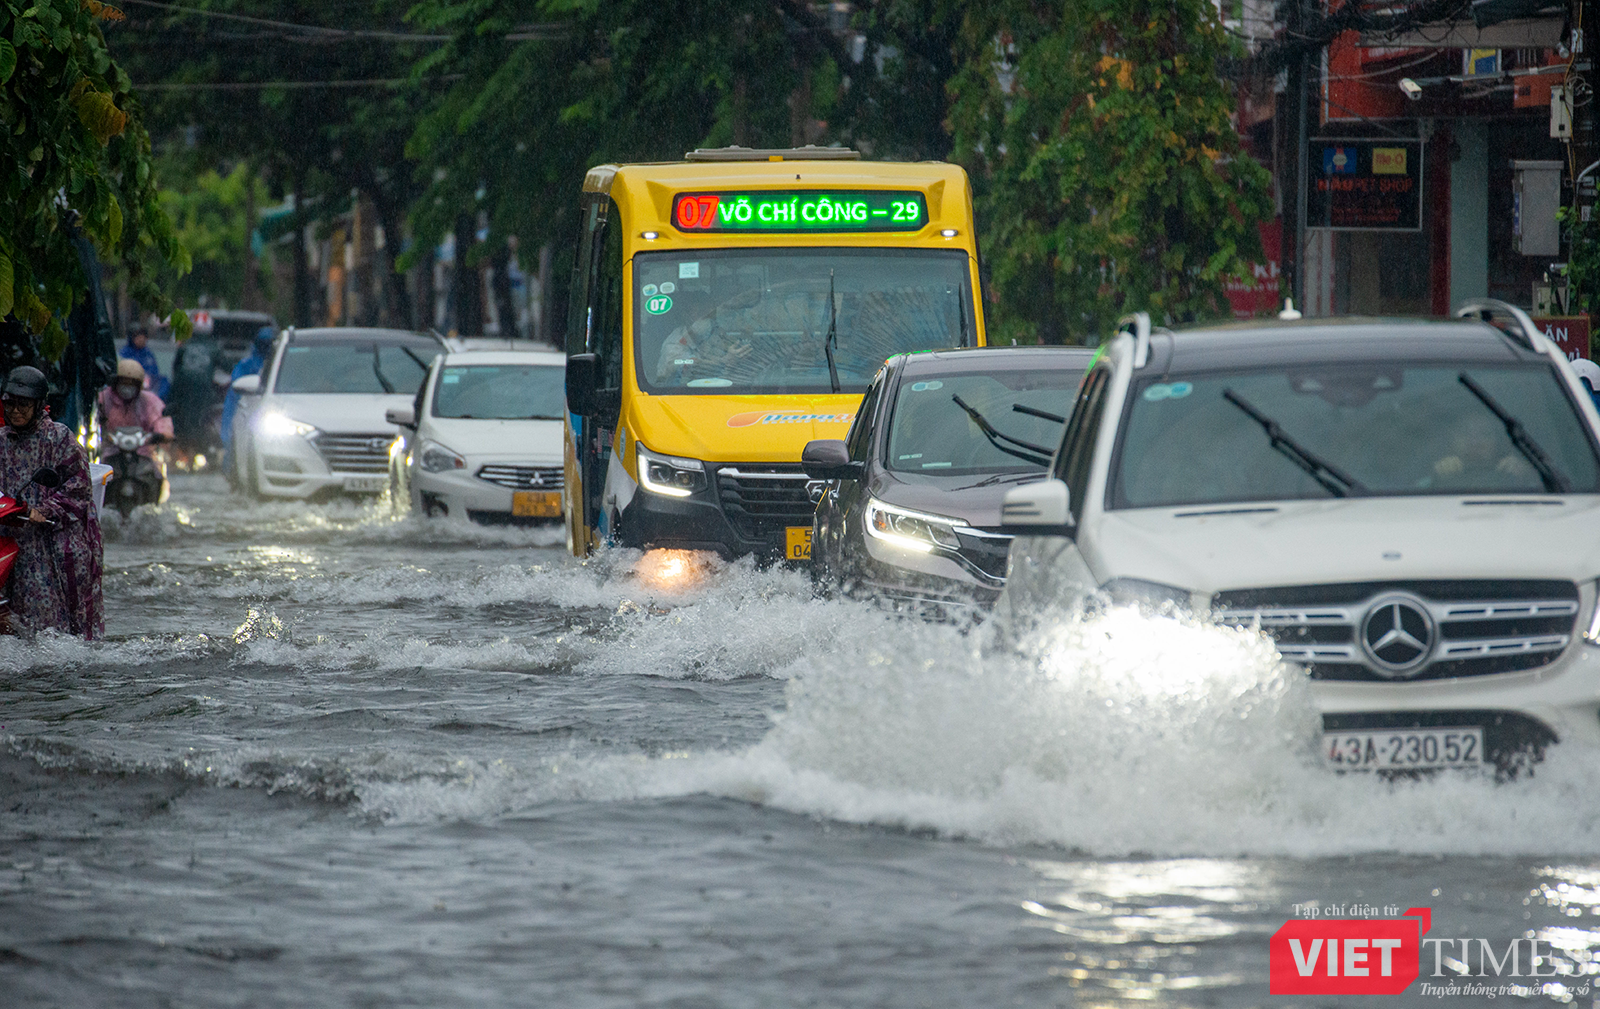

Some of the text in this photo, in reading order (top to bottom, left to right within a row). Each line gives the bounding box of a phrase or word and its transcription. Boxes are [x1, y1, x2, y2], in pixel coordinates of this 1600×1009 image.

[1379, 178, 1413, 193] SHOP
[677, 195, 719, 228] 07
[719, 198, 752, 222] VÕ
[758, 196, 799, 222] CHÍ
[802, 198, 867, 222] CÔNG
[891, 202, 919, 221] 29
[650, 298, 667, 311] 07
